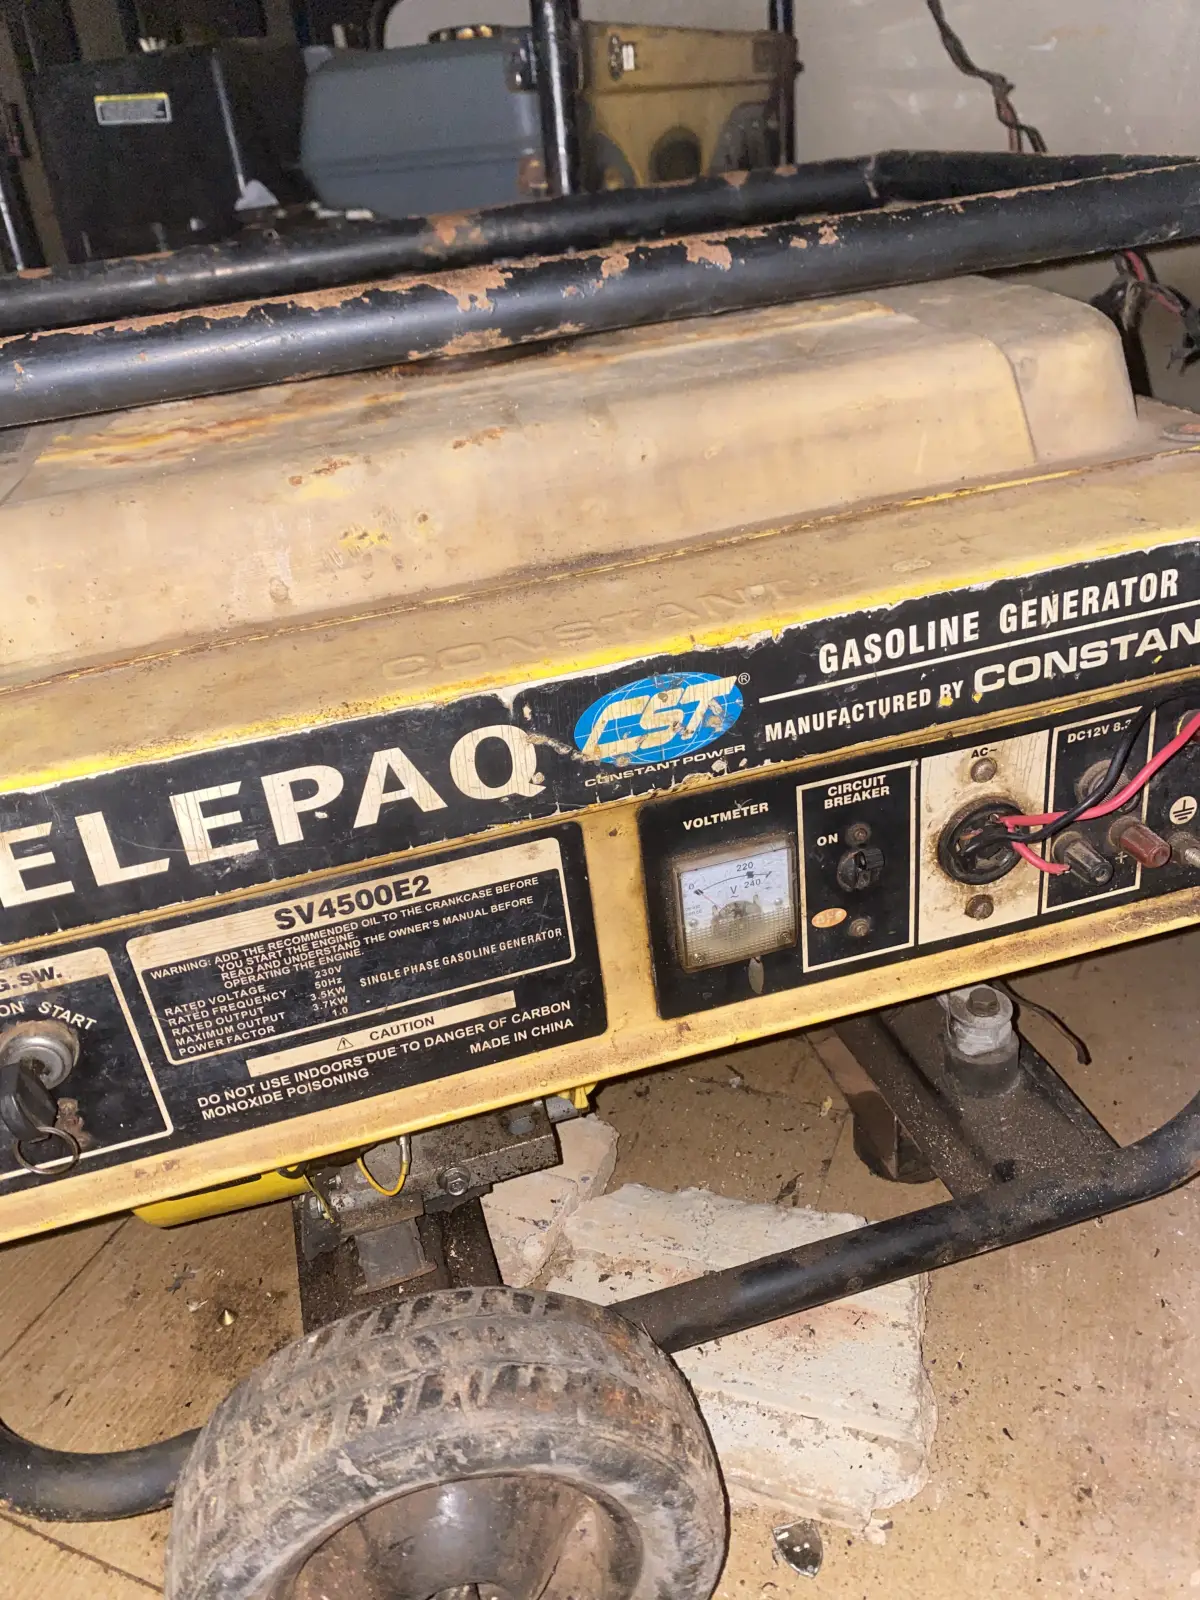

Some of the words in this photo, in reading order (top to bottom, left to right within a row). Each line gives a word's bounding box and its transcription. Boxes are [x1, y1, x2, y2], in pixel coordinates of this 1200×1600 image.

[818, 612, 979, 675] GASOLINE
[999, 568, 1179, 634] GENERATOR
[764, 689, 931, 743] MANUFACTURED
[939, 680, 964, 706] BY
[1067, 724, 1110, 743] DC12V
[584, 760, 681, 787] CONSTANT
[683, 744, 746, 765] POWER
[827, 774, 886, 796] CIRCUIT
[0, 724, 546, 910] ELEPAQ
[683, 802, 769, 830] VOLTMETER
[824, 785, 890, 810] BREAKER
[817, 833, 838, 847] ON
[736, 862, 754, 872] 220
[744, 879, 761, 889] 240
[274, 875, 431, 930] SV4500E2
[150, 960, 212, 980] WARNING:
[215, 952, 239, 965] ADD
[242, 945, 266, 958] THE
[268, 922, 359, 950] RECOMMENDED
[361, 917, 380, 928] OIL
[382, 912, 398, 922] TO
[400, 905, 424, 918] THE
[425, 886, 493, 912] CRANKCASE
[496, 876, 539, 894] BEFORE
[218, 961, 243, 972] YOU
[247, 950, 283, 966] START
[285, 943, 309, 956] THE
[312, 932, 359, 949] ENGINE.
[221, 966, 254, 981] READ
[256, 959, 281, 974] AND
[284, 940, 361, 966] UNDERSTAND
[363, 933, 386, 945] THE
[388, 919, 440, 940] OWNER'S
[442, 908, 489, 925] MANUAL
[491, 896, 534, 913] BEFORE
[224, 966, 291, 989] OPERATING
[293, 960, 317, 972] THE
[319, 948, 364, 966] ENGINE.
[359, 968, 402, 988] SINGLE
[403, 959, 441, 976] PHASE
[442, 944, 497, 966] GASOLINE
[499, 928, 563, 951] GENERATOR
[0, 1001, 25, 1017] ON
[38, 1001, 97, 1030] START
[164, 1000, 206, 1017] RATED
[208, 984, 267, 1005] VOLTAGE
[314, 965, 342, 979] 230V
[168, 1009, 210, 1027] RATED
[212, 989, 287, 1016] FREQUENCY
[314, 977, 343, 990] 50Hz
[171, 1020, 213, 1037] RATED
[215, 1006, 265, 1026] OUTPUT
[310, 985, 347, 1001] 3.5KW
[175, 1025, 235, 1047] MAXIMUM
[236, 1011, 286, 1031] OUTPUT
[312, 995, 348, 1011] 3.7KW
[178, 1038, 224, 1057] POWER
[226, 1025, 276, 1044] FACTOR
[332, 1006, 349, 1017] 1.0
[369, 1016, 435, 1041] CAUTION
[469, 1034, 511, 1054] MADE
[514, 1027, 528, 1042] IN
[531, 1018, 575, 1038] CHINA
[198, 1091, 220, 1109] DO
[224, 1082, 257, 1102] NOT
[260, 1074, 290, 1093] USE
[293, 1056, 362, 1084] INDOORS
[366, 1046, 398, 1065] DUE
[400, 1038, 422, 1055] TO
[425, 1022, 486, 1047] DANGER
[489, 1015, 510, 1031] OF
[511, 1000, 571, 1025] CARBON
[201, 1091, 283, 1121] MONOXIDE
[287, 1067, 370, 1100] POISONING
